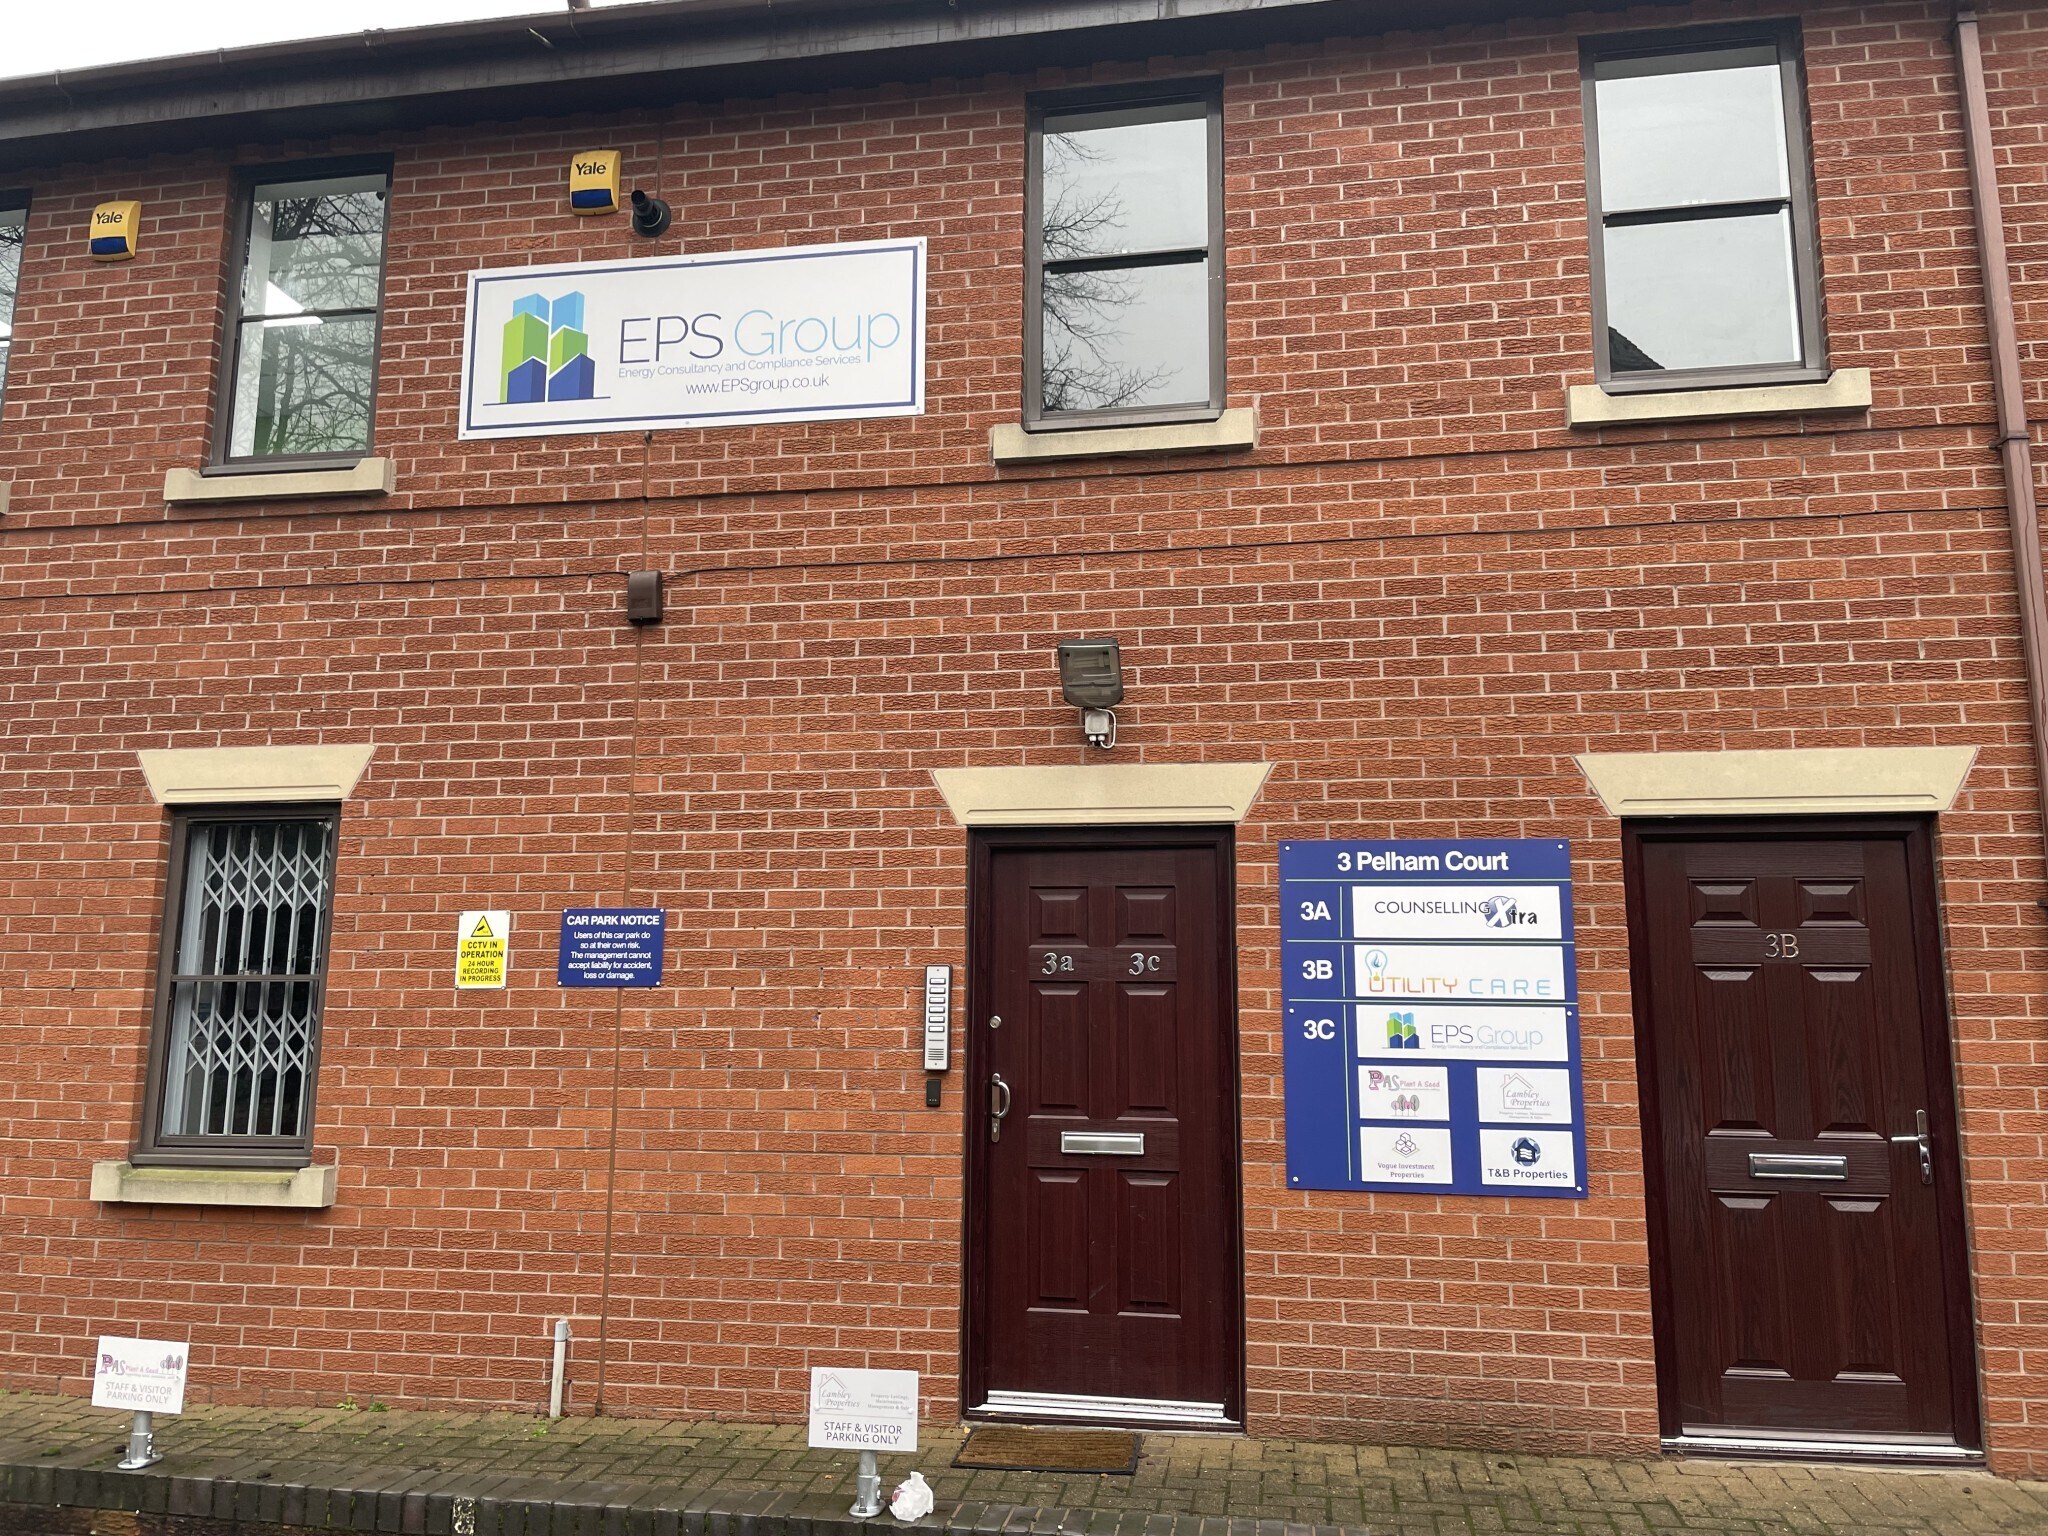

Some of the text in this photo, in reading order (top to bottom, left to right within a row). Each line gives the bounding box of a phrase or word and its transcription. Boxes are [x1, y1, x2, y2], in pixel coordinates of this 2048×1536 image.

[576, 162, 606, 175] Yale
[96, 212, 122, 224] Yale
[619, 310, 900, 364] EPS Group
[618, 354, 861, 379] Energy Consultancy and Compliance Services
[686, 374, 830, 396] www.EPSgroup.co.uk
[1338, 851, 1508, 871] 3 Pelham Court
[1301, 901, 1331, 920] 3A
[1374, 902, 1490, 914] COUNSELLING
[567, 916, 659, 925] CAR PARK NOTICE
[625, 932, 640, 940] park
[1765, 934, 1799, 958] 3B
[585, 952, 627, 960] management
[568, 962, 590, 970] accept
[591, 962, 612, 970] liability
[1042, 953, 1074, 974] 3a
[606, 972, 635, 980] damage.
[1302, 960, 1333, 980] 3B
[1369, 976, 1551, 995] UTILITY CARE
[1304, 1019, 1334, 1040] 3C
[1431, 1024, 1543, 1050] EPS Group
[1506, 1090, 1539, 1100] Lambley
[1511, 1099, 1550, 1108] Properties
[1488, 1169, 1568, 1180] T&B Properties
[106, 1382, 129, 1391] STAFF
[140, 1385, 172, 1395] VISITOR
[822, 1390, 851, 1399] Lambley
[107, 1391, 170, 1404] PARKING ONLY
[825, 1399, 860, 1408] Properties
[824, 1422, 902, 1434] STAFF & VISITOR
[826, 1432, 900, 1444] PARKING ONLY
